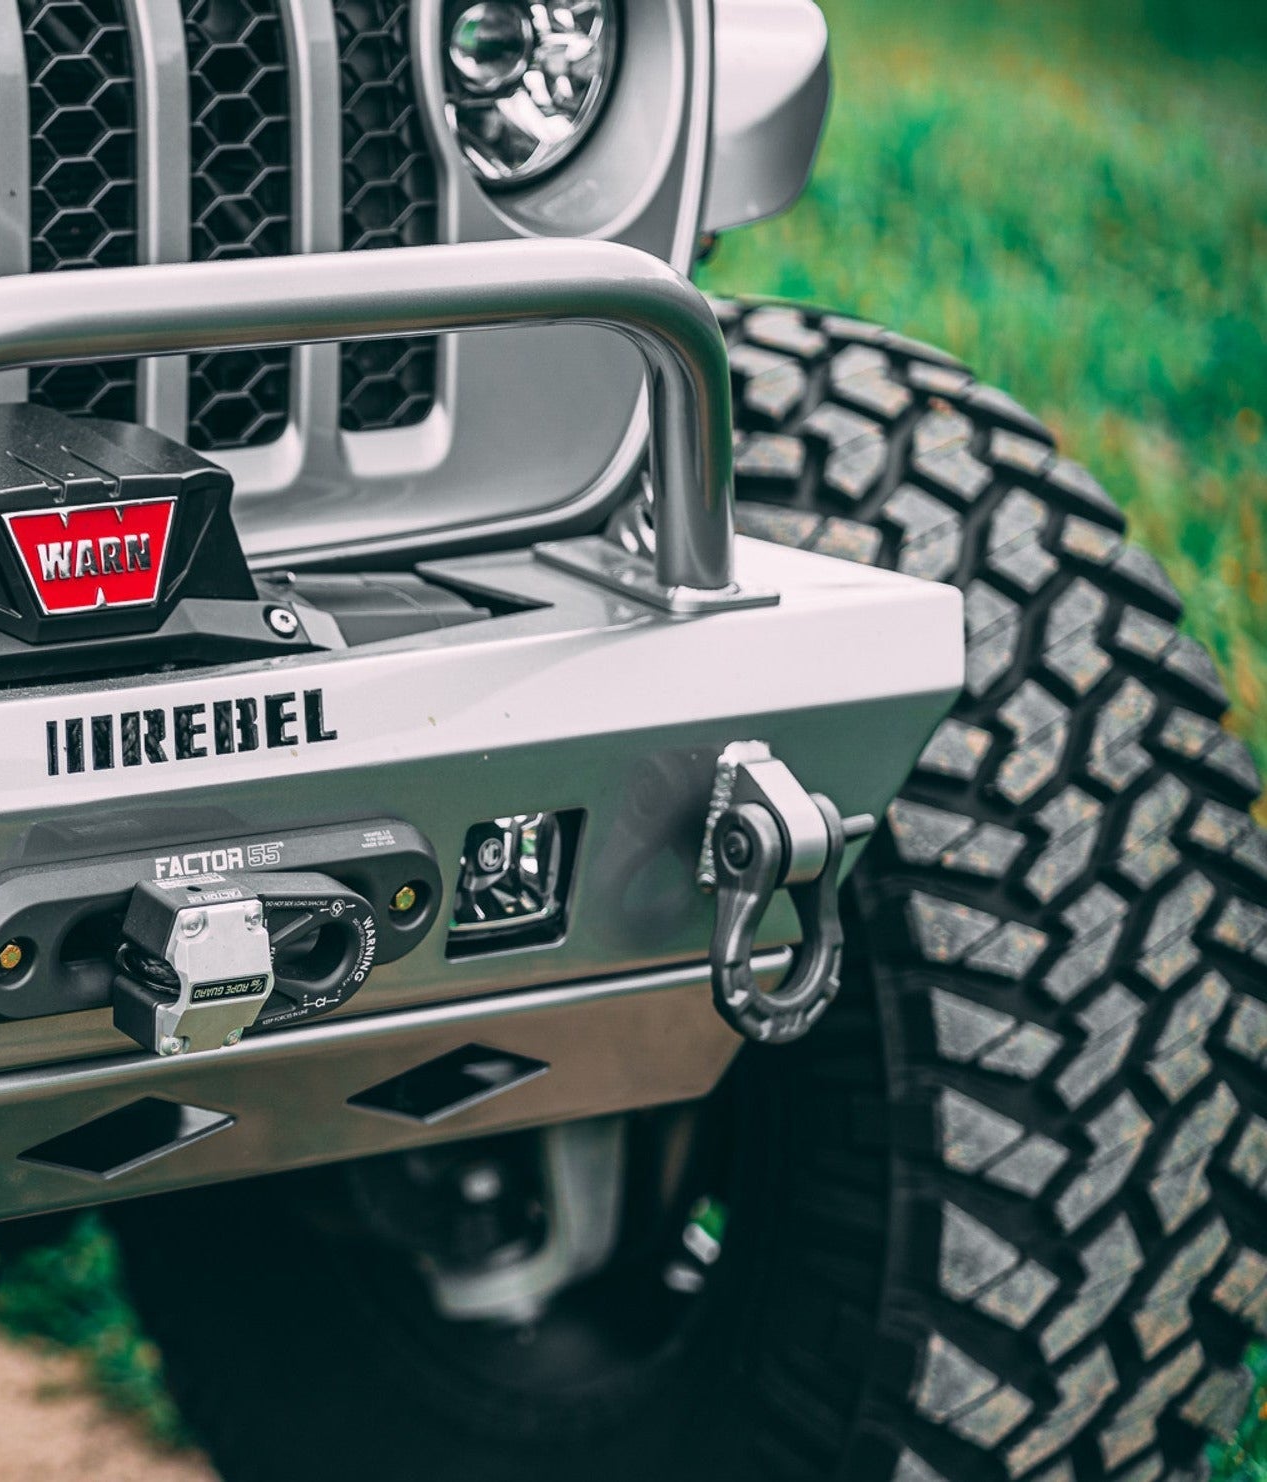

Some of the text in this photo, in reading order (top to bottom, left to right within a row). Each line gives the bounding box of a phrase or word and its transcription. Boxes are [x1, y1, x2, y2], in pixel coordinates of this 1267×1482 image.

[36, 532, 153, 582] WARN
[120, 688, 338, 767] REBEL
[155, 842, 281, 878] FACTOR 55
[354, 915, 376, 982] WARNING
[193, 986, 225, 999] GUARD
[224, 982, 250, 995] ROPE
